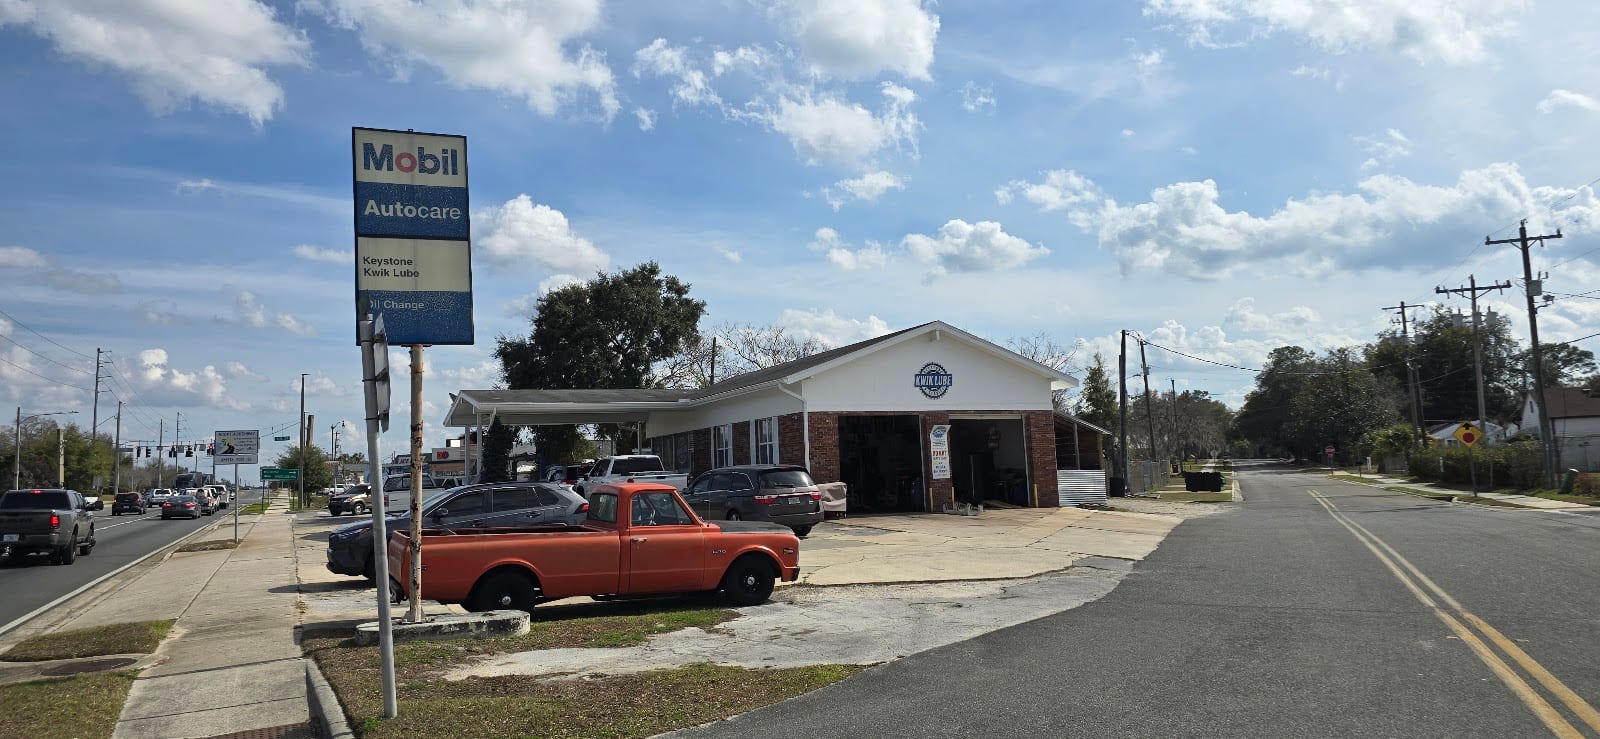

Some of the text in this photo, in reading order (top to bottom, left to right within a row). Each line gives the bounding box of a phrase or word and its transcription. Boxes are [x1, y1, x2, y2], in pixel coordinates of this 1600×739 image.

[363, 142, 458, 175] Mobil
[364, 199, 462, 220] Autocare
[362, 256, 413, 266] Keystone
[363, 267, 420, 278] Kwik Lube
[383, 299, 425, 311] Change
[915, 375, 952, 386] KWIK LUBE
